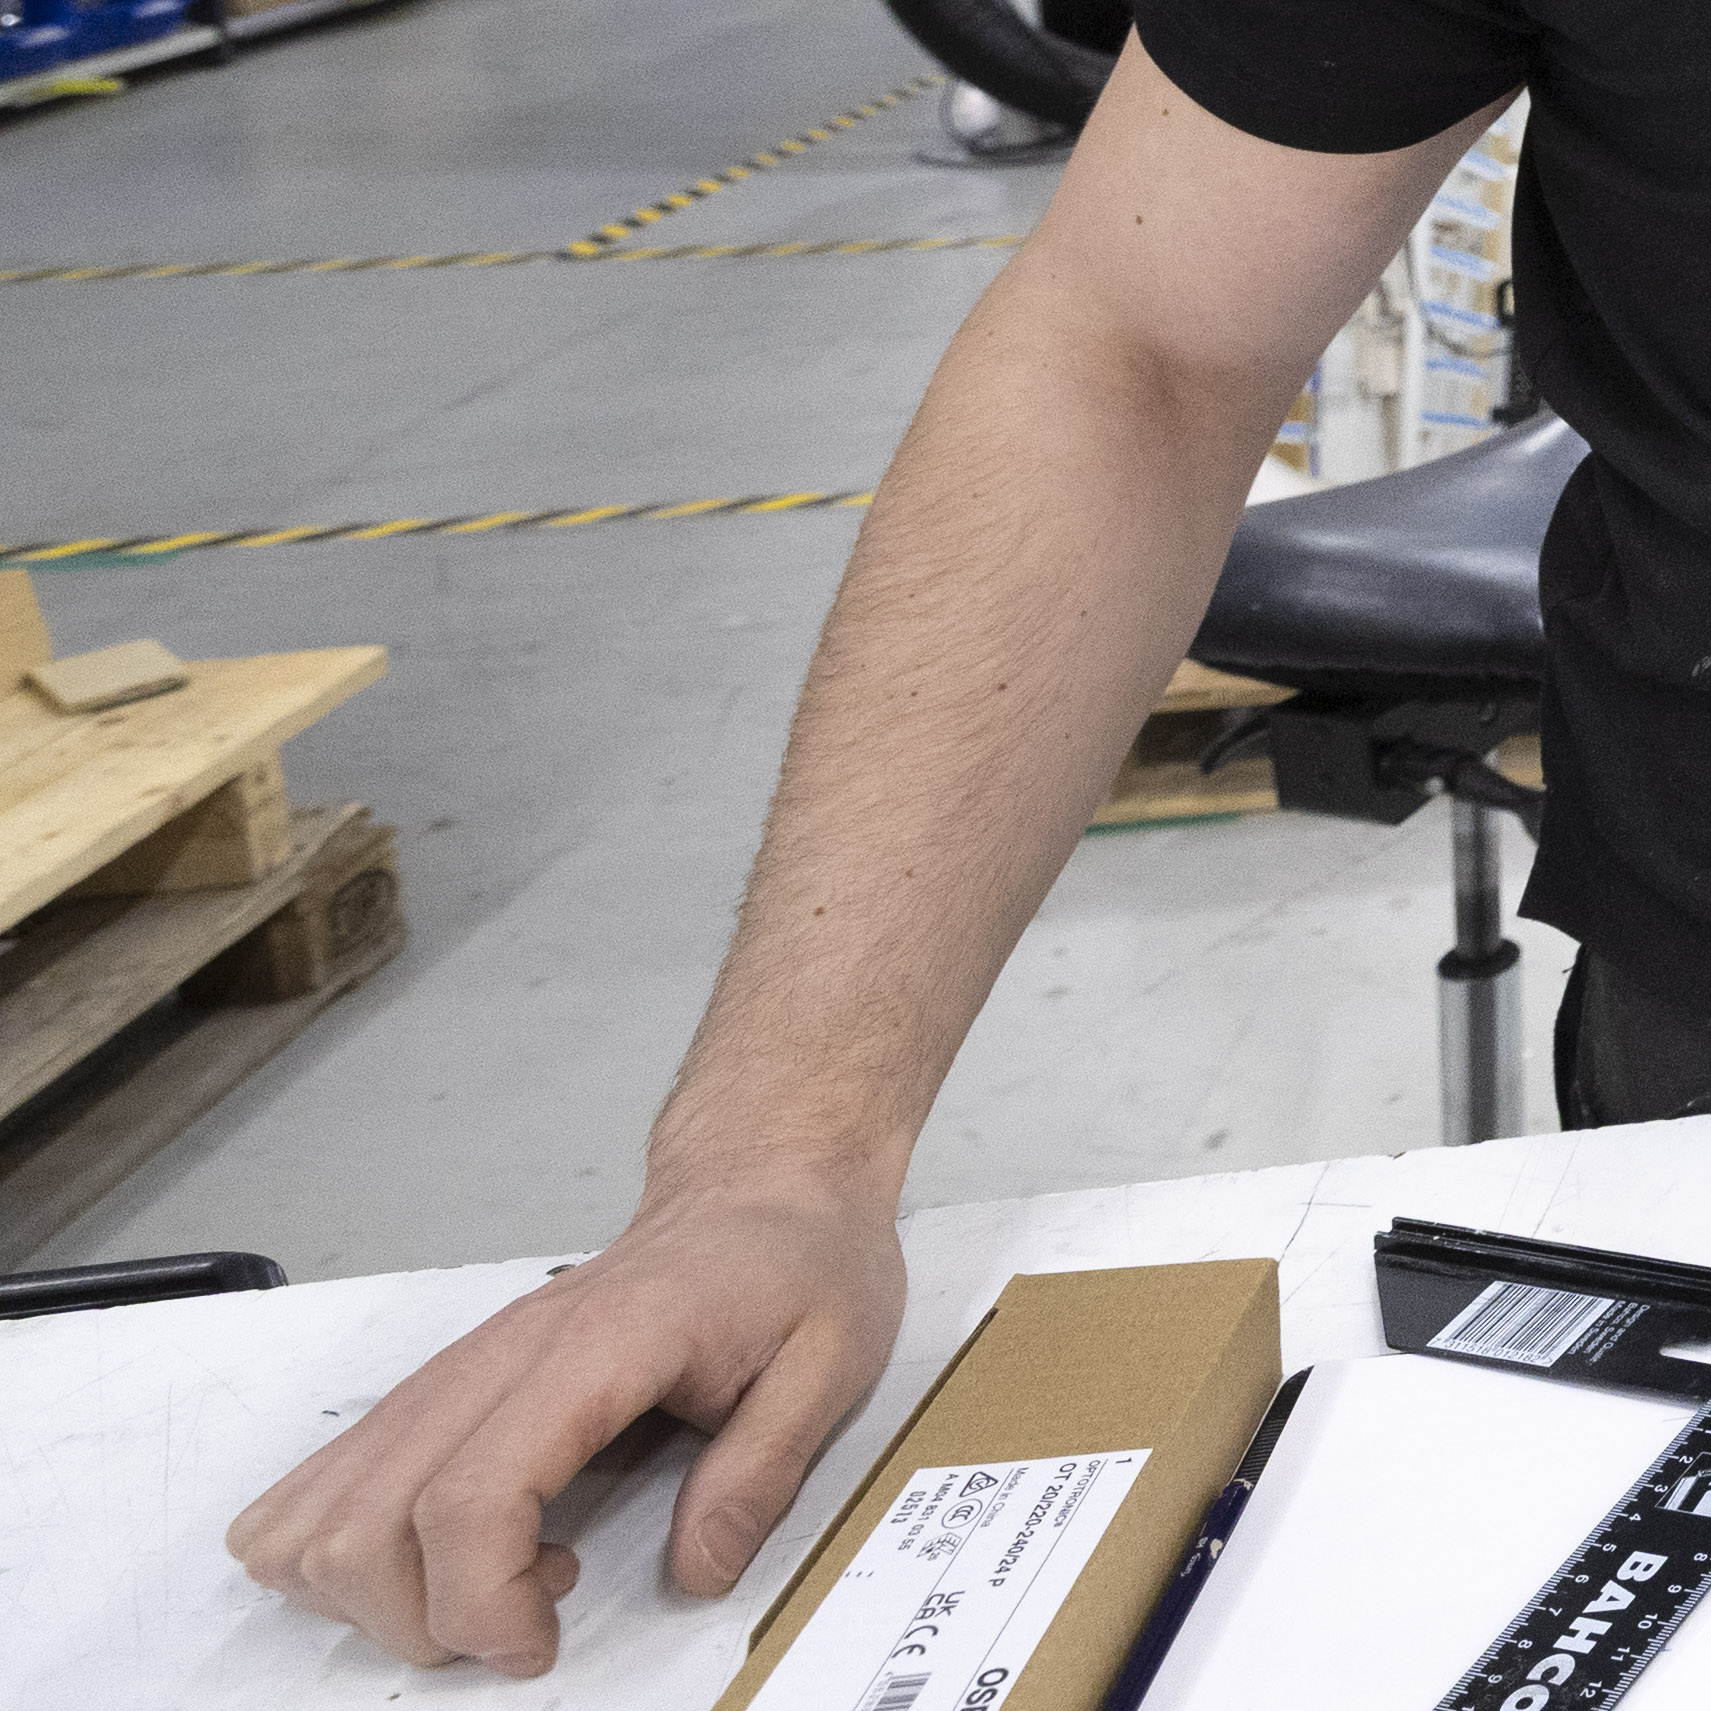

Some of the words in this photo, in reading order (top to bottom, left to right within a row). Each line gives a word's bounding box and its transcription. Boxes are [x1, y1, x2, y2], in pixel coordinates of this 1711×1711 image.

[1678, 1455, 1693, 1464] 2
[1054, 1462, 1077, 1481] OT
[1005, 1467, 1029, 1491] Made
[1654, 1484, 1668, 1493] 3
[980, 1501, 1005, 1528] China
[1629, 1512, 1642, 1522] 4
[989, 1484, 1063, 1575] 20/220-240/24
[1602, 1543, 1617, 1553] 5
[1693, 1552, 1708, 1562] 8
[988, 1578, 1006, 1587] P
[1575, 1574, 1590, 1584] 6
[1667, 1584, 1682, 1594] 9
[935, 1590, 965, 1616] UK
[1548, 1606, 1563, 1616] 7
[1637, 1613, 1658, 1629] 10
[1499, 1550, 1668, 1711] BAHCO
[1517, 1639, 1533, 1649] 8
[1610, 1646, 1631, 1662] 11
[1488, 1674, 1503, 1684] 9
[1579, 1681, 1603, 1699] 12
